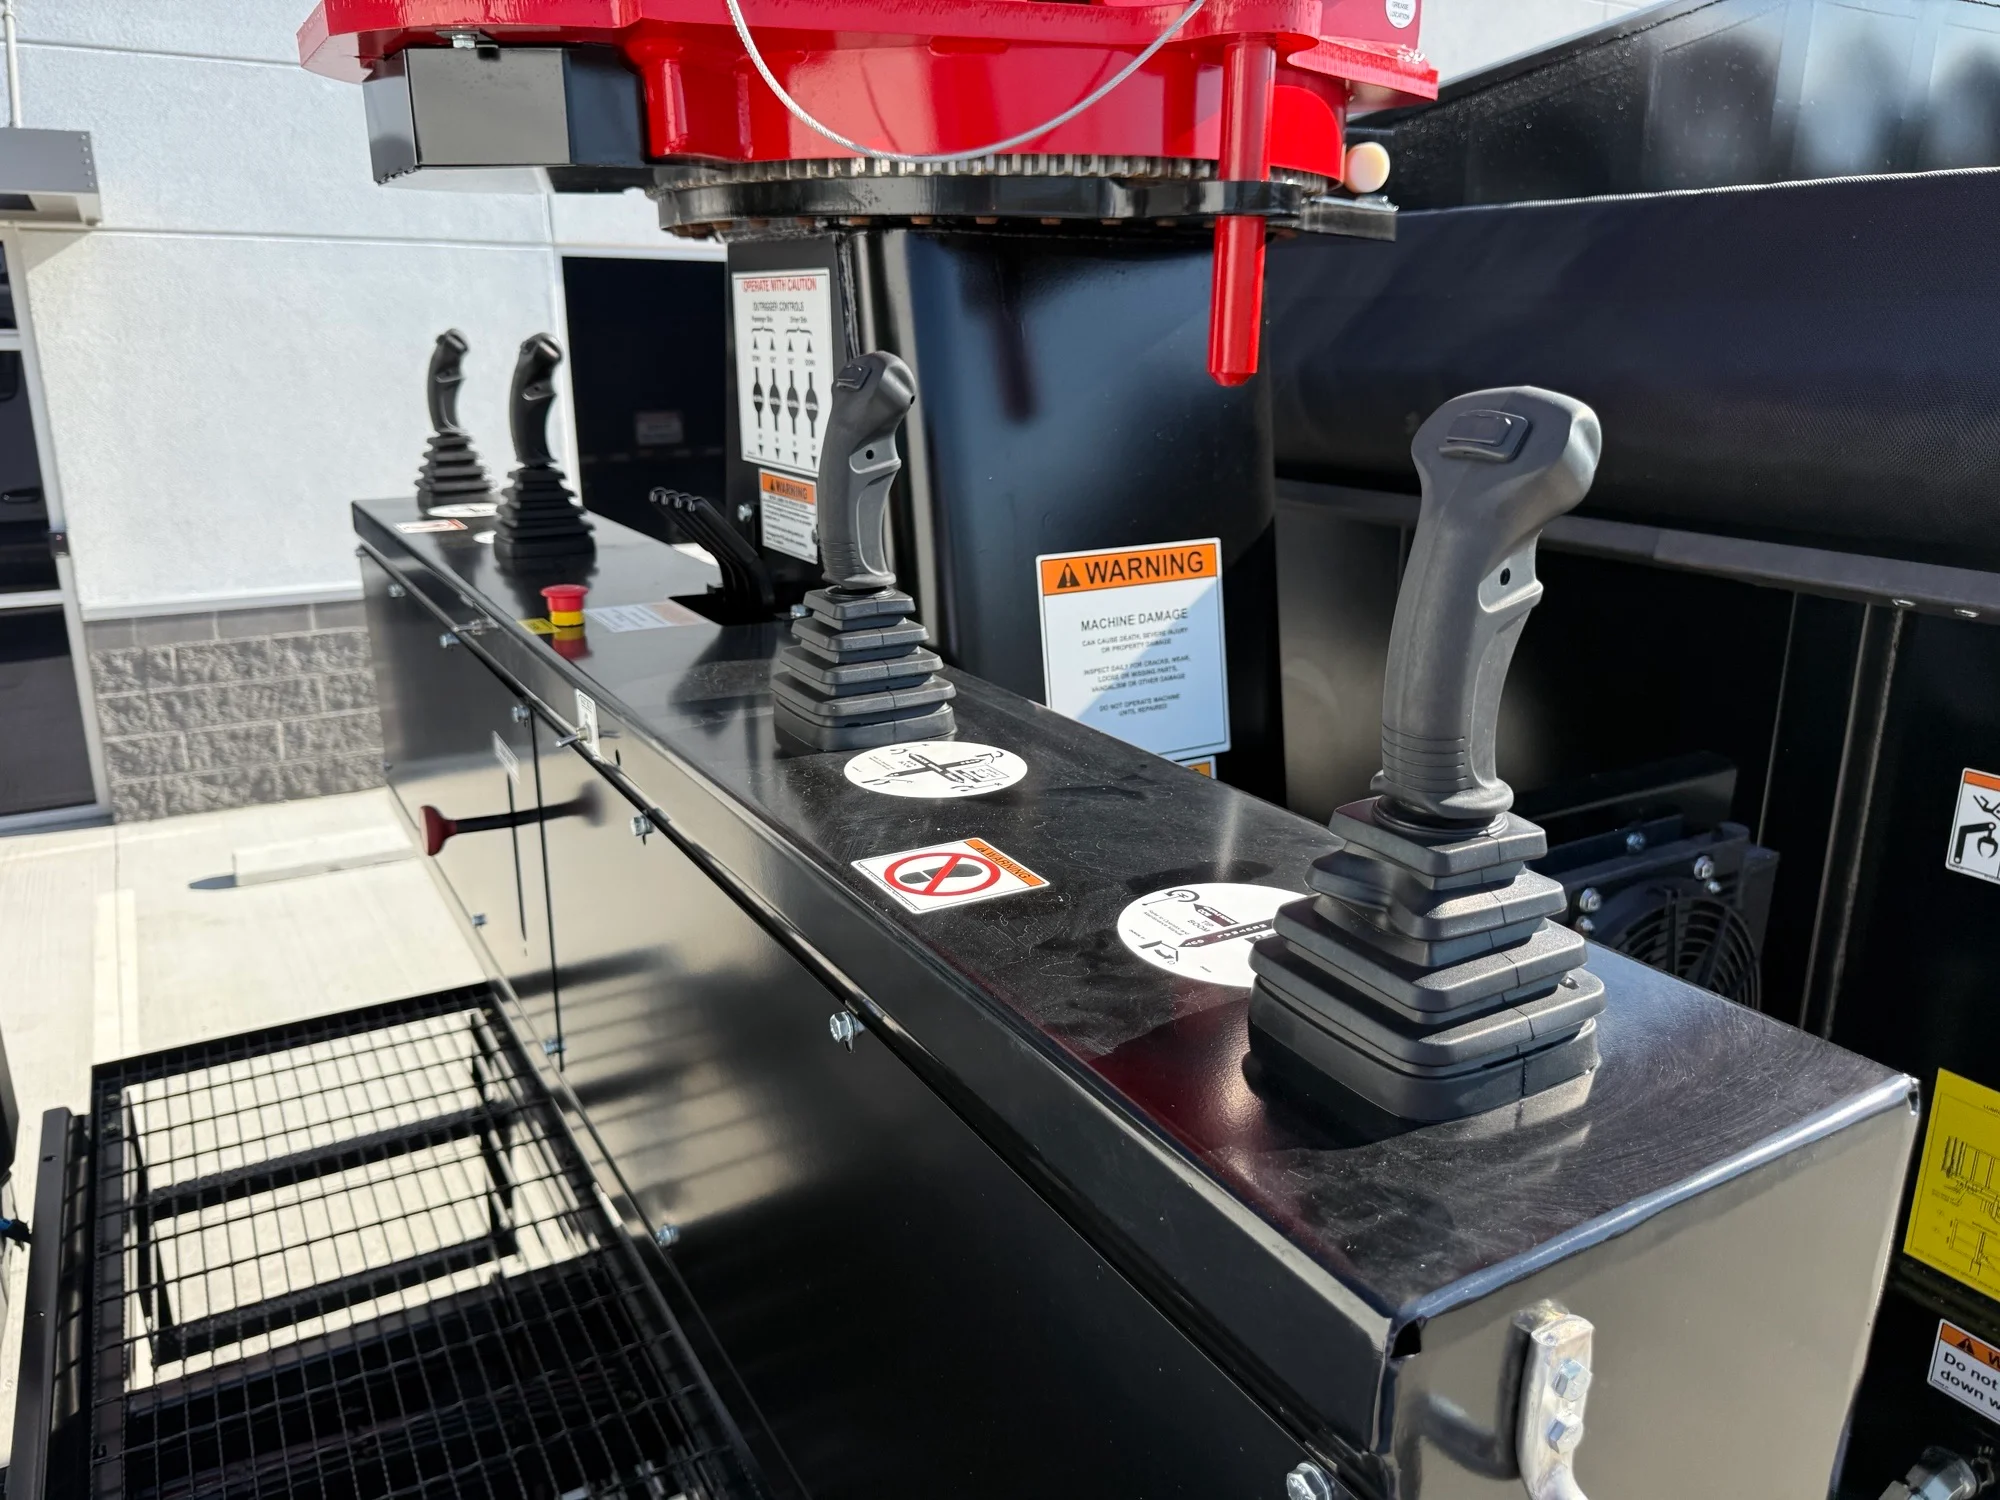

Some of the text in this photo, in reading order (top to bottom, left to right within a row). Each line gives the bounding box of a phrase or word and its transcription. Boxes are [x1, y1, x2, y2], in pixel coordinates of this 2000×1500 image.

[743, 277, 817, 292] OPERATE WITH CAUTION
[753, 302, 804, 311] OUTRIGGER CONTROLS
[775, 480, 807, 500] WARNING
[1085, 552, 1203, 584] WARNING
[1081, 608, 1188, 631] MACHINE DAMAGE
[1097, 636, 1118, 645] CAUSE
[1112, 642, 1144, 651] PROPERTY
[1084, 666, 1109, 675] INSPECT
[1131, 669, 1156, 677] MISSING
[1138, 678, 1158, 686] OTHER
[1160, 673, 1185, 682] DAMAGE
[1124, 698, 1152, 708] OPERATE
[1154, 694, 1180, 703] MACHINE
[1138, 703, 1167, 713] REPAIRED
[986, 850, 1031, 878] WARNING
[1187, 920, 1211, 932] BOOM
[1944, 1352, 1966, 1372] Do
[1971, 1369, 1998, 1391] not
[1940, 1370, 1984, 1400] down
